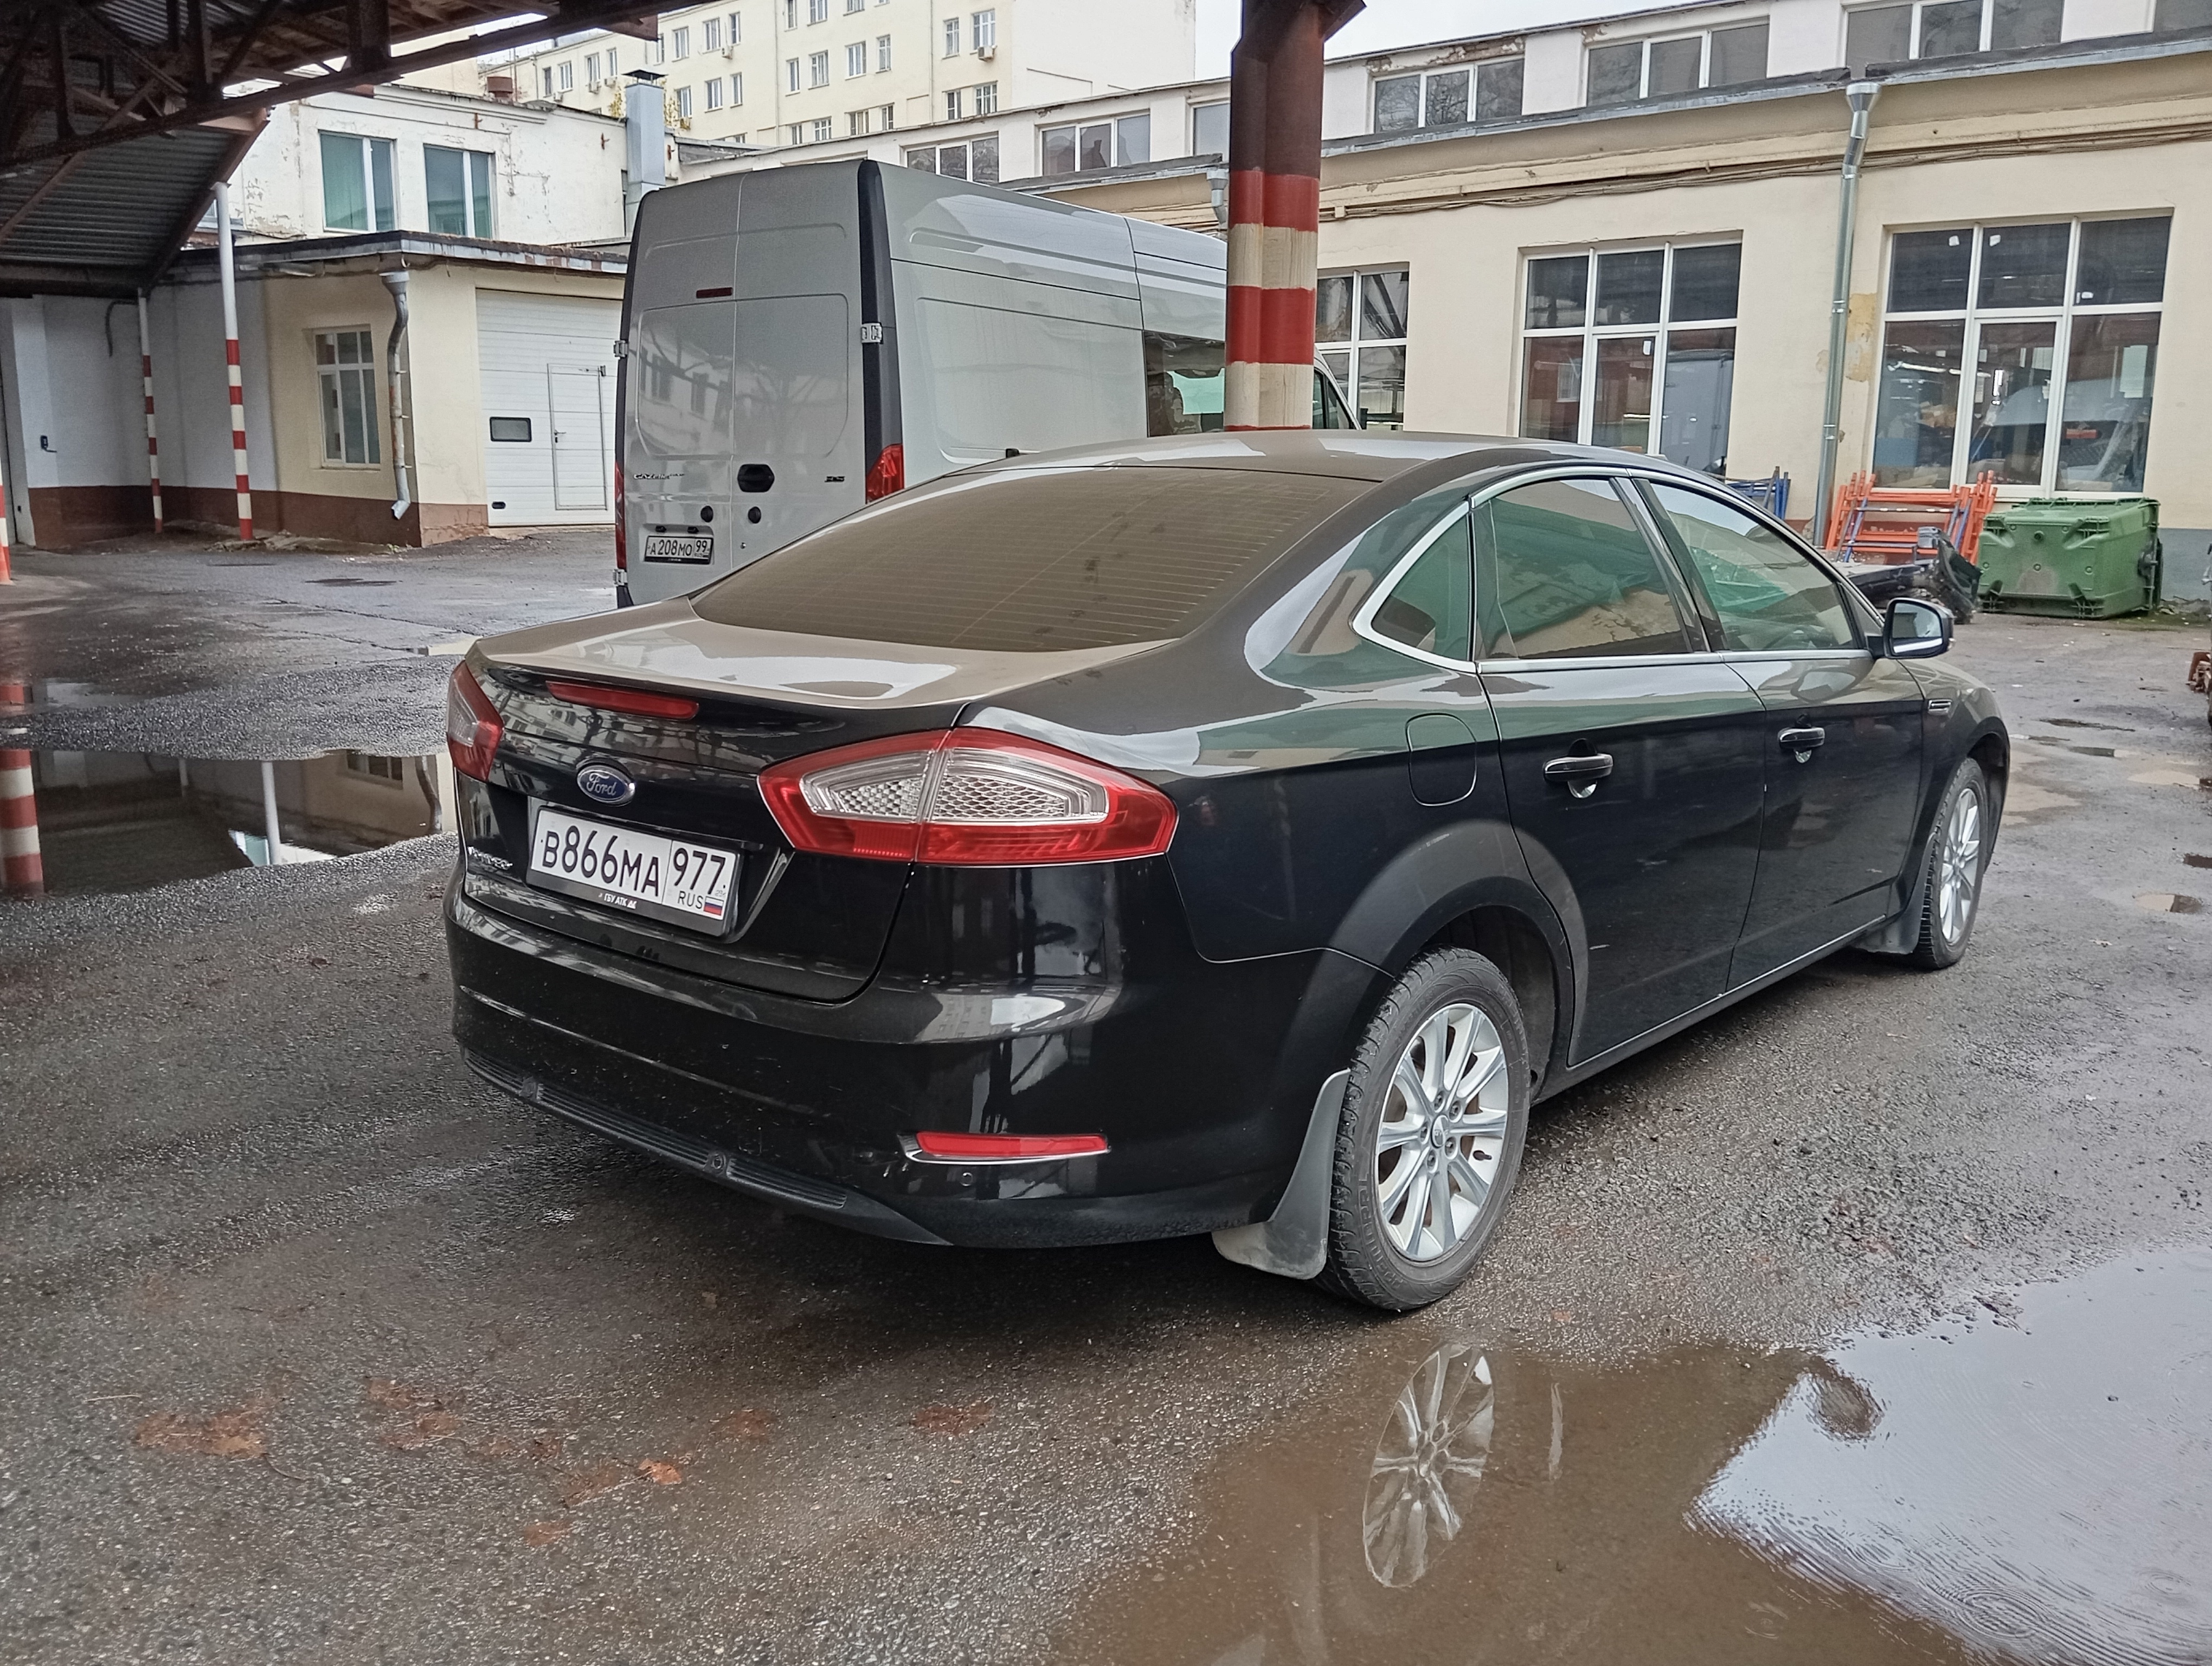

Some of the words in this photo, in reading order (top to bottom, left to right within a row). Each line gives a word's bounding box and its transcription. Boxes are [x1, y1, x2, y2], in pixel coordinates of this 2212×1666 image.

[696, 540, 708, 553] 99
[587, 772, 618, 796] Ford
[542, 825, 659, 897] В866МА
[673, 847, 726, 895] 977
[677, 890, 704, 909] RUS
